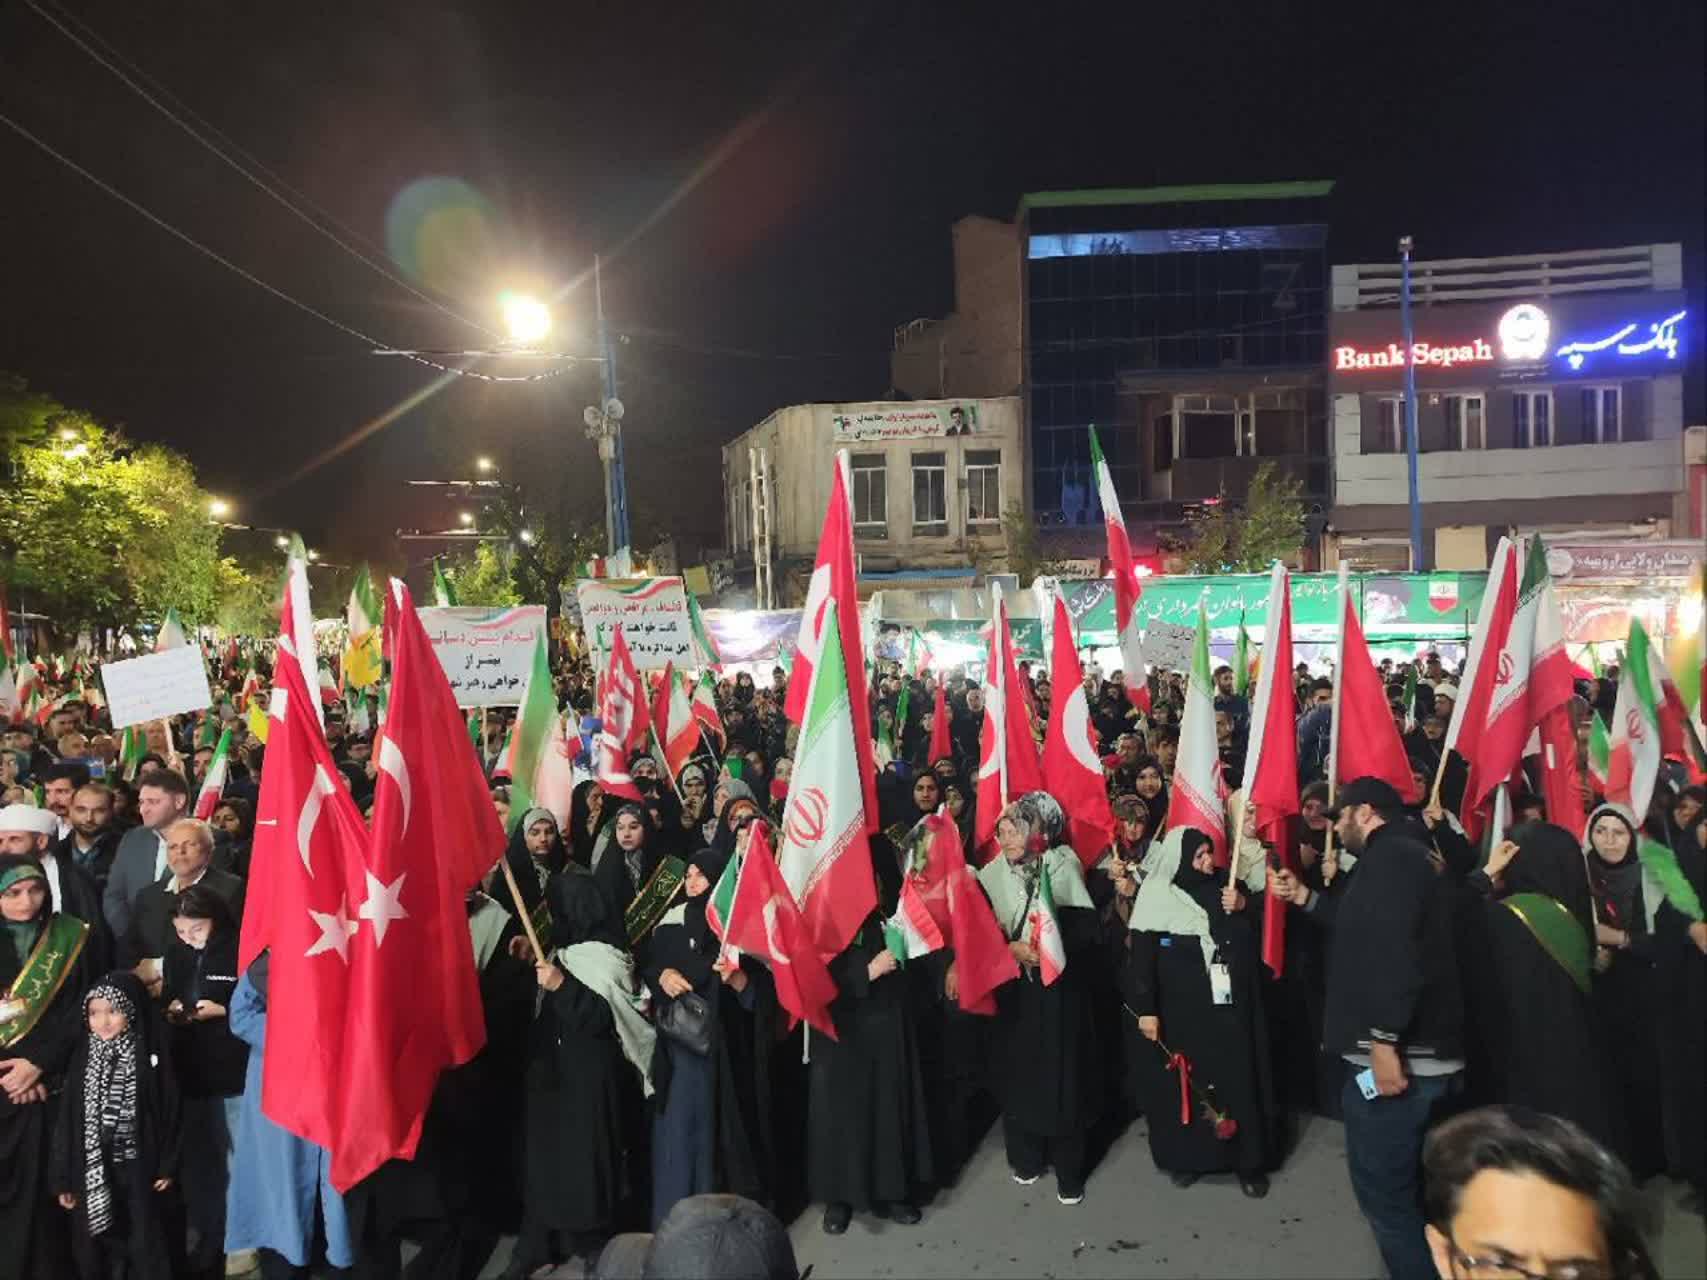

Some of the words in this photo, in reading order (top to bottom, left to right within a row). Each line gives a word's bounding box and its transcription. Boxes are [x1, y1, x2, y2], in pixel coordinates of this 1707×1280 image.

[1556, 323, 1637, 370] سپه
[1618, 309, 1687, 359] بانک
[1335, 344, 1404, 370] Bank
[1411, 338, 1493, 369] Sepah
[465, 653, 473, 669] از
